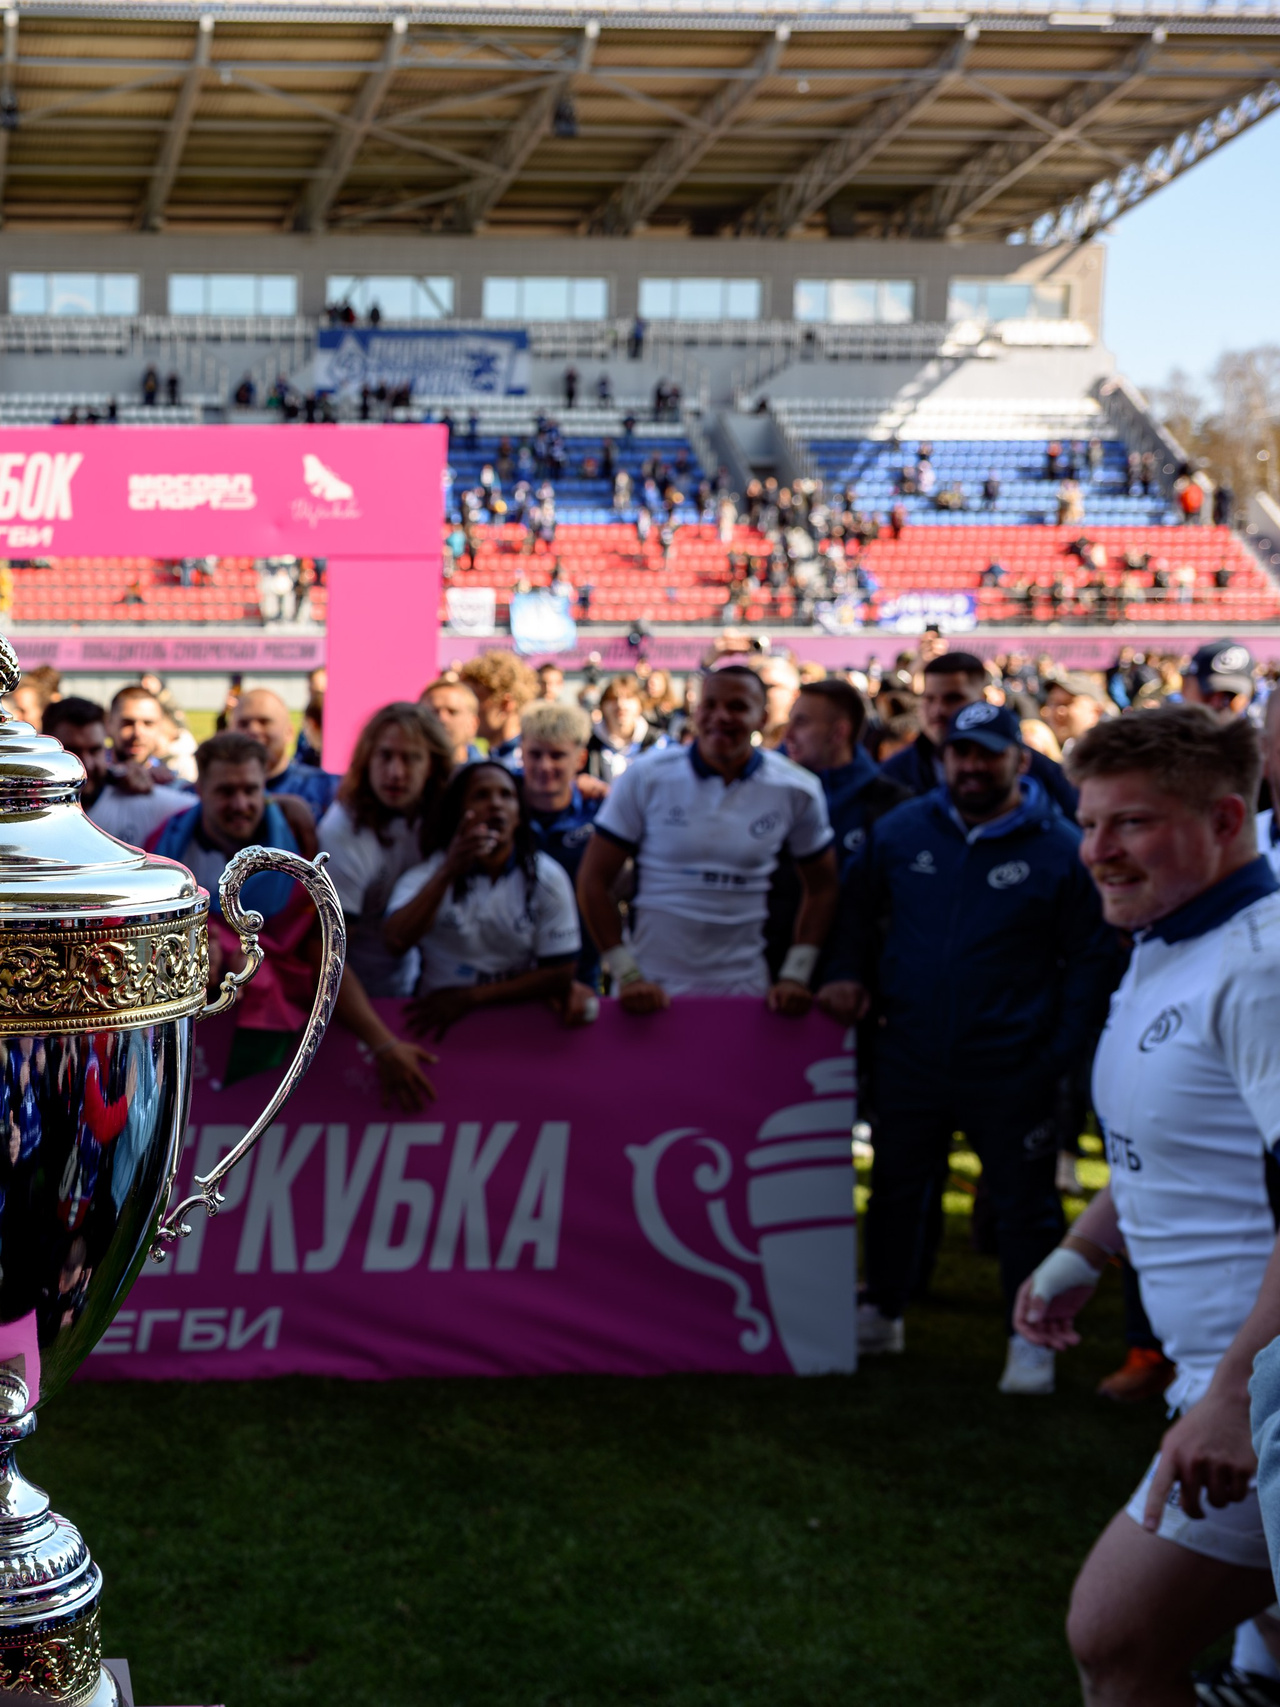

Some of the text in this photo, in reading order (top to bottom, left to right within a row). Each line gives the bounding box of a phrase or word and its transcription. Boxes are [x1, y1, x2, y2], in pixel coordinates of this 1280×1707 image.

[128, 473, 252, 491] МОСОБЛ
[128, 491, 254, 510] СПОРТ
[91, 1306, 283, 1355] ЕГБИ
